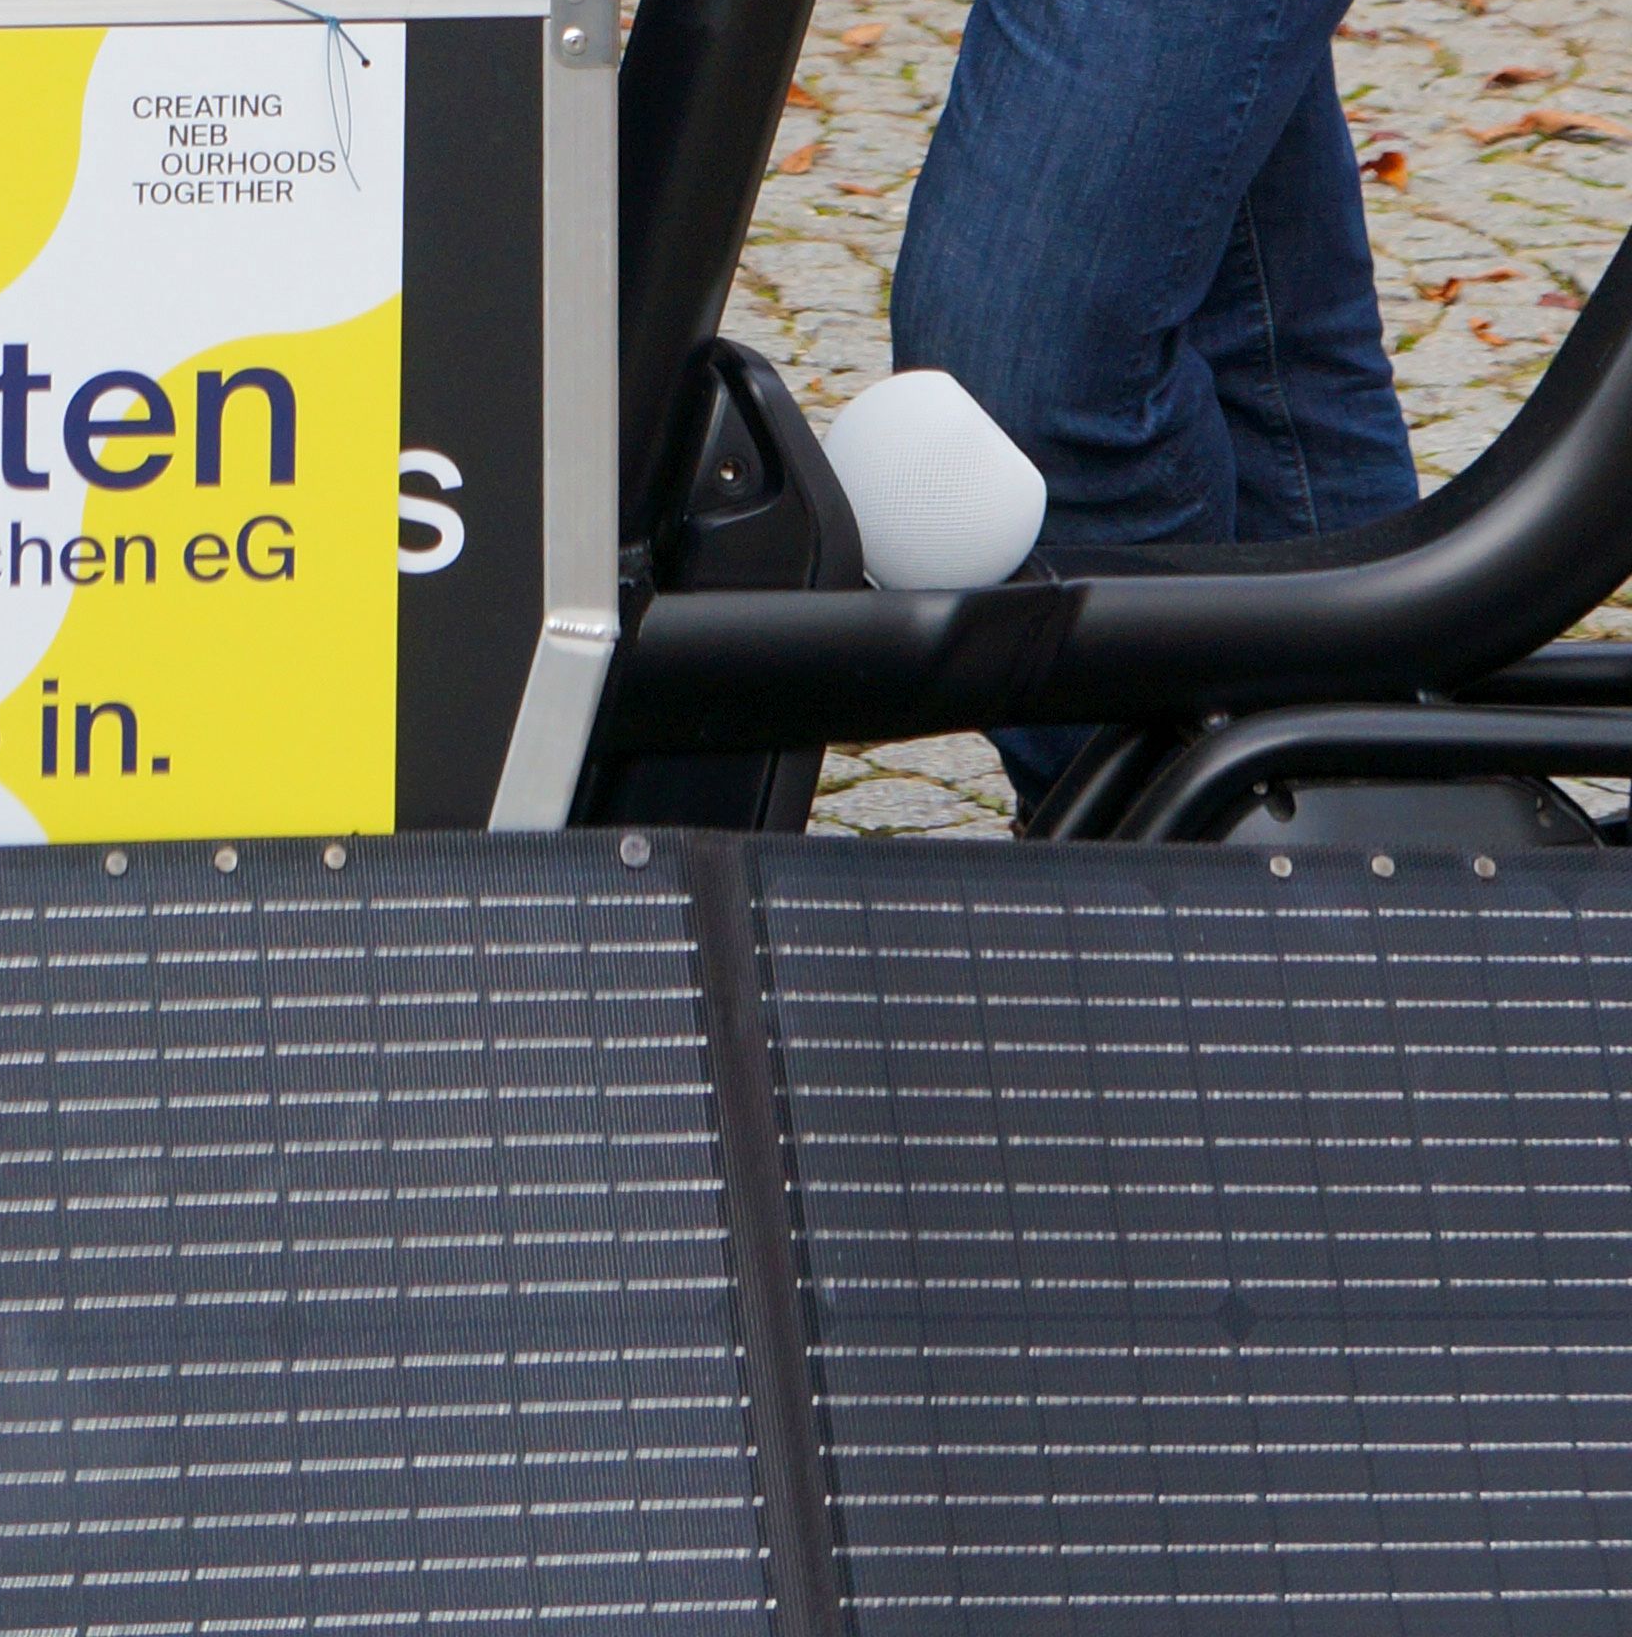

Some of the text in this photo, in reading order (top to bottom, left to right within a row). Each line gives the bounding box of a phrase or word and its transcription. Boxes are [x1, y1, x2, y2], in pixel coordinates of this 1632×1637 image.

[131, 94, 283, 119] CREATING
[169, 123, 228, 147] NEB
[161, 151, 337, 176] OURHOODS
[132, 180, 294, 205] TOGETHER
[183, 515, 296, 582] eG
[41, 678, 171, 777] in.
